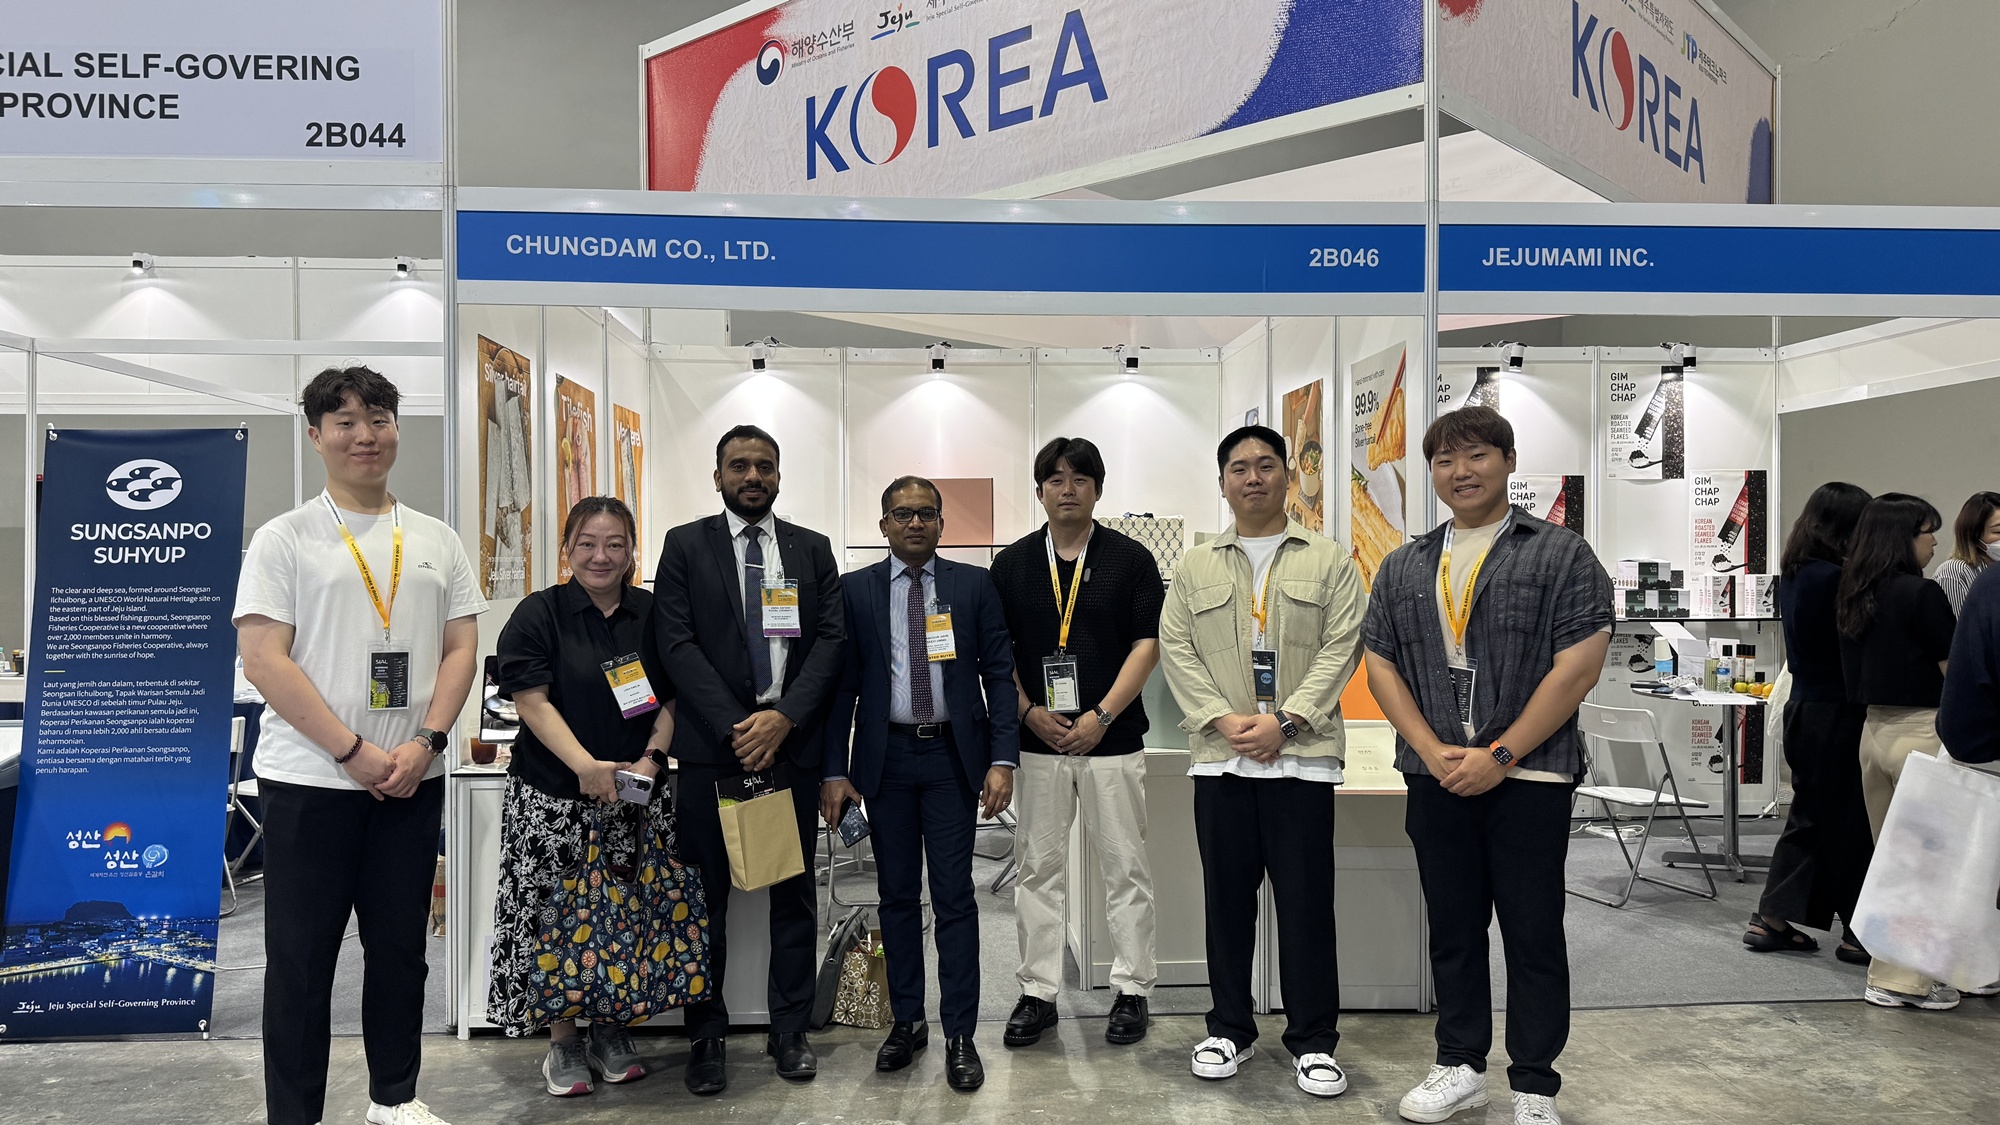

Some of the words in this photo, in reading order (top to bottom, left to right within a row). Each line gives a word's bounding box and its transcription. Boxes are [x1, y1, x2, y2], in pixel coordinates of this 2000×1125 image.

[876, 5, 913, 32] Jeju
[791, 20, 855, 58] 해양수산부
[812, 53, 827, 61] Oceans
[0, 52, 63, 78] IAL
[73, 53, 361, 81] SELF-GOVERING
[806, 9, 1108, 180] KOREA
[1572, 0, 1705, 184] KOREA
[0, 92, 180, 120] PROVINCE
[305, 122, 406, 148] 2B044
[506, 234, 657, 257] CHUNGDAM
[665, 239, 716, 263] CO.,
[724, 240, 776, 261] LTD.
[1309, 248, 1379, 267] 2B046
[1482, 247, 1602, 267] JEJUMAMI
[1609, 247, 1655, 267] INC.
[1610, 372, 1628, 380] GIM
[1610, 383, 1636, 391] CHAP
[1355, 390, 1379, 417] 99.9%
[1610, 394, 1636, 402] CHAP
[561, 394, 593, 433] Tilefish
[1510, 481, 1528, 490] GIM
[1694, 477, 1712, 485] GIM
[1510, 492, 1536, 501] CHAP
[1694, 487, 1719, 496] CHAP
[1694, 498, 1719, 506] CHAP
[70, 522, 212, 541] SUNGSANPO
[94, 546, 186, 564] SUHYUP
[96, 587, 113, 595] deep
[178, 586, 210, 594] Seongsan
[143, 614, 169, 622] ground,
[170, 614, 211, 622] Seongsanpo
[78, 624, 118, 632] Cooperative
[141, 633, 172, 641] harmony.
[142, 642, 184, 650] Cooperative,
[185, 642, 208, 650] always
[45, 652, 74, 660] together
[136, 652, 155, 660] hope.
[42, 690, 75, 698] Seongsan
[76, 690, 114, 698] Ilchulbong,
[175, 708, 187, 716] jadi
[66, 830, 101, 849] 성산
[104, 850, 139, 869] 성산
[17, 1000, 41, 1013] Jeju
[48, 1001, 64, 1011] Jeju
[66, 1000, 96, 1010] Special
[99, 999, 159, 1009] Self-Governing
[162, 997, 196, 1006] Province
